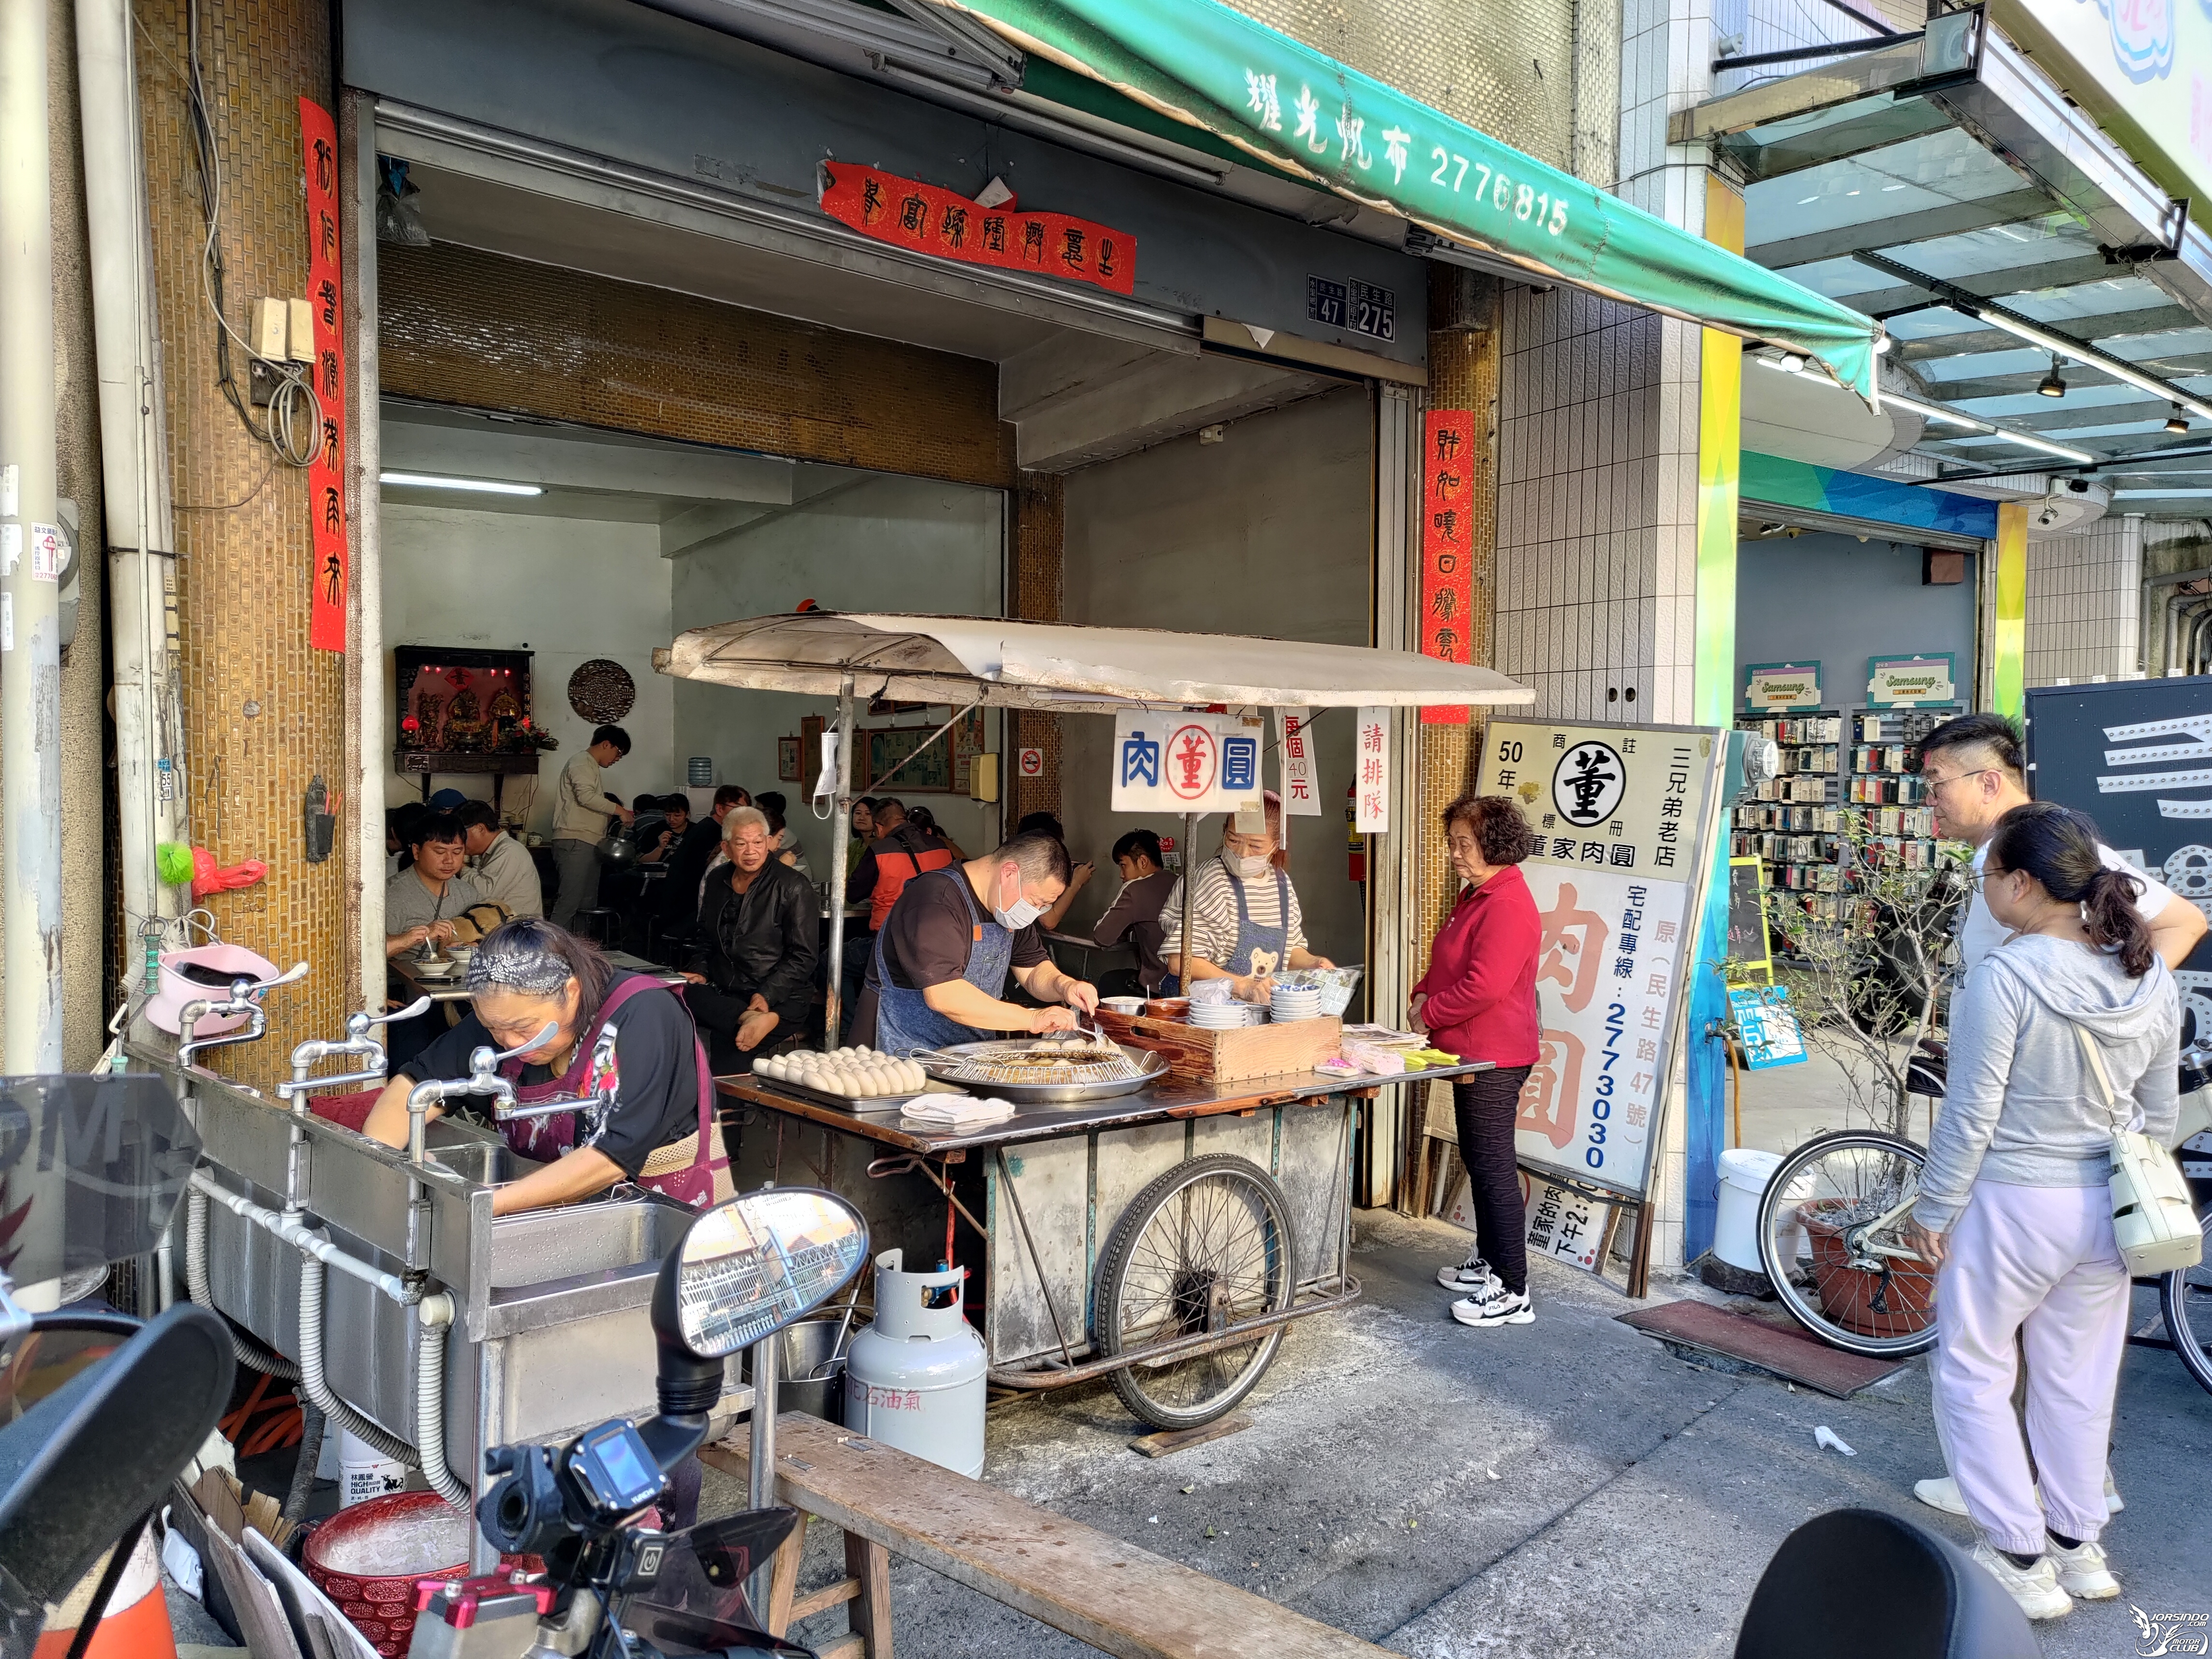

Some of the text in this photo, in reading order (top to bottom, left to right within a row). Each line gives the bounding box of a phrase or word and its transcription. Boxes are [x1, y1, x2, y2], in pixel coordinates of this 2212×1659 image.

[1430, 147, 1569, 236] 2776815
[1320, 283, 1343, 297] 民生路
[1360, 285, 1393, 306] 民生路
[1321, 299, 1339, 323] 47
[1359, 302, 1393, 338] 275
[1762, 682, 1805, 694] Samsung
[1886, 675, 1936, 688] Samsung
[1362, 723, 1384, 818] 請排隊
[1563, 750, 1615, 819] 董
[1654, 747, 1691, 868] 三兄弟老店
[1527, 834, 1636, 868] 董家肉圓
[1527, 1173, 1569, 1250] 董家的肉
[351, 1486, 380, 1494] QUALITY
